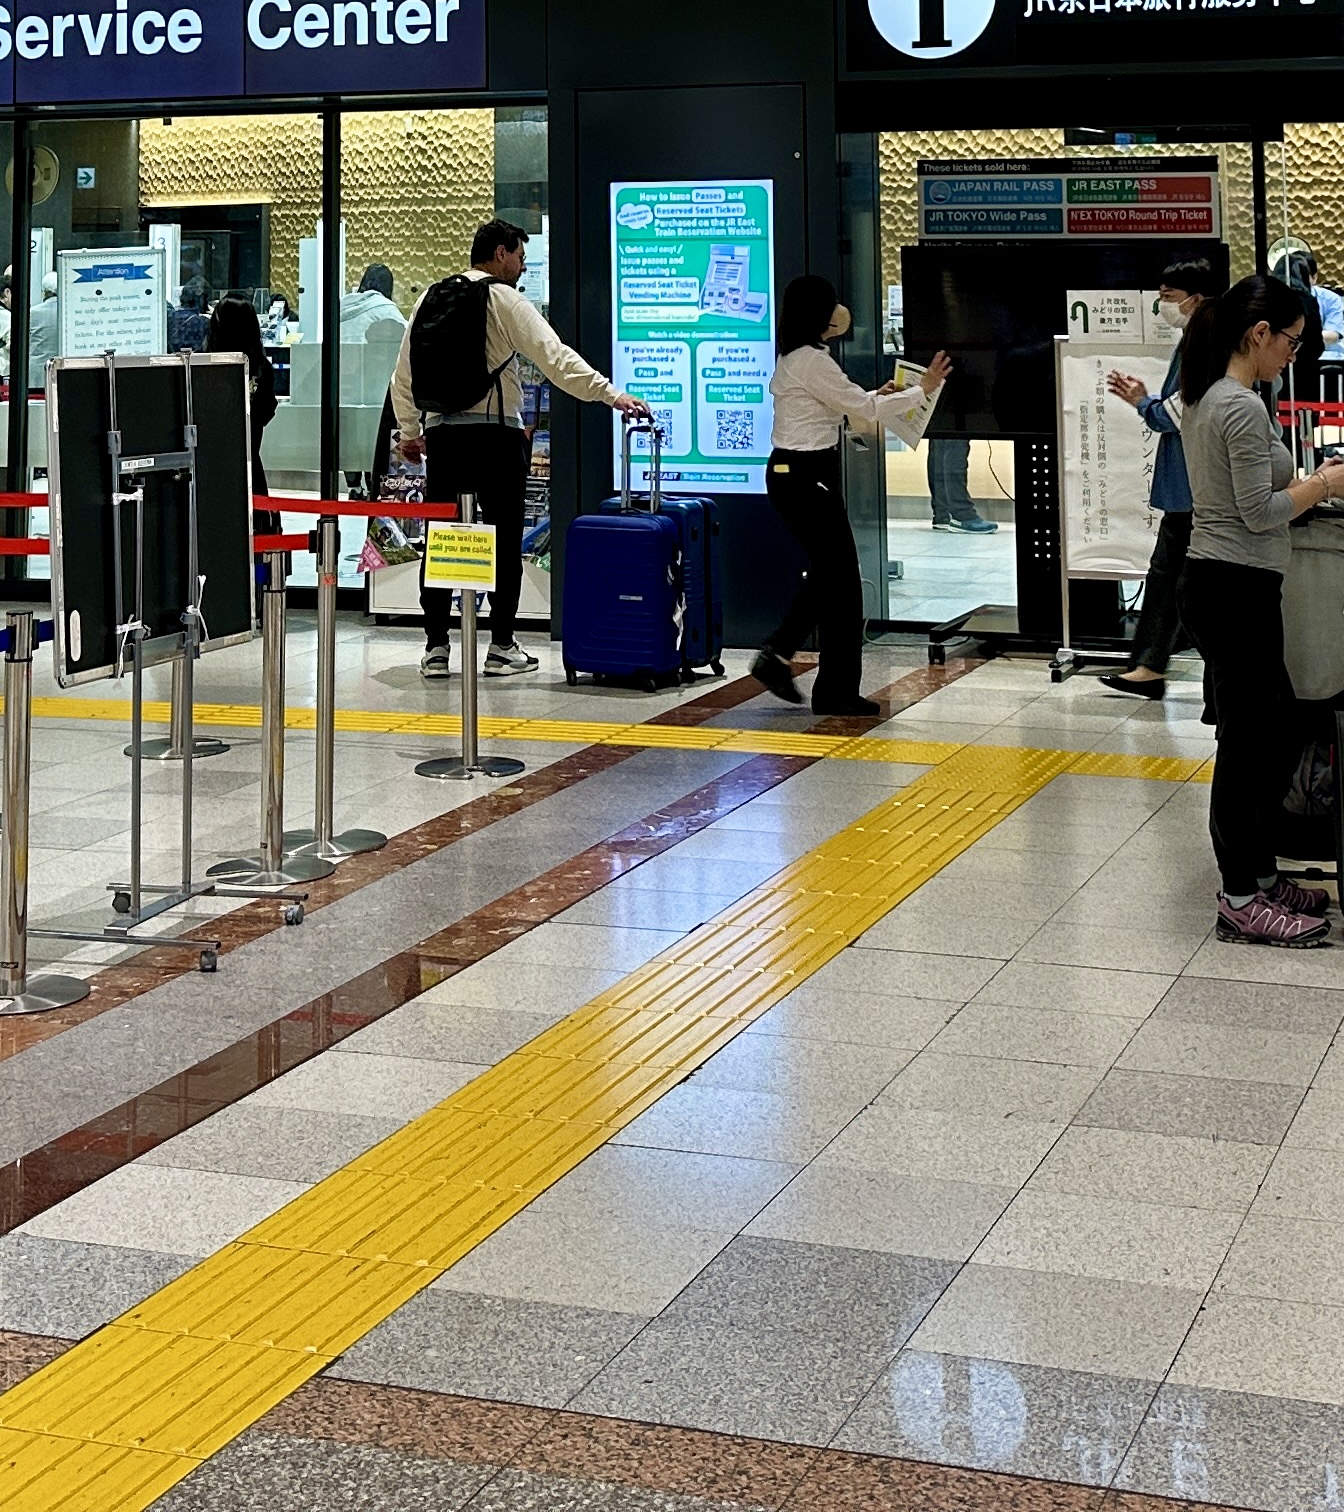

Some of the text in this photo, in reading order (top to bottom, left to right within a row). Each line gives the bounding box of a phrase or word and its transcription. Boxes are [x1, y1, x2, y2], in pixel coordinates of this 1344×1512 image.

[924, 164, 950, 172] These
[953, 164, 982, 172] tickets
[985, 163, 1004, 171] sold
[952, 181, 1054, 192] JAPAN RAIL PASS
[1072, 180, 1157, 191] JR EAST PASS
[640, 193, 657, 201] How
[696, 192, 722, 200] Passes
[728, 191, 743, 199] and
[657, 207, 693, 215] Reserved
[716, 206, 743, 214] Tickets
[1095, 211, 1126, 220] TOKYO
[1129, 210, 1157, 220] Round
[1160, 210, 1178, 221] Trip
[1180, 210, 1207, 219] Ticket
[930, 211, 1047, 221] JR TOKYO Wide Pass
[1141, 418, 1159, 537] ウンターです。
[433, 532, 455, 541] Please
